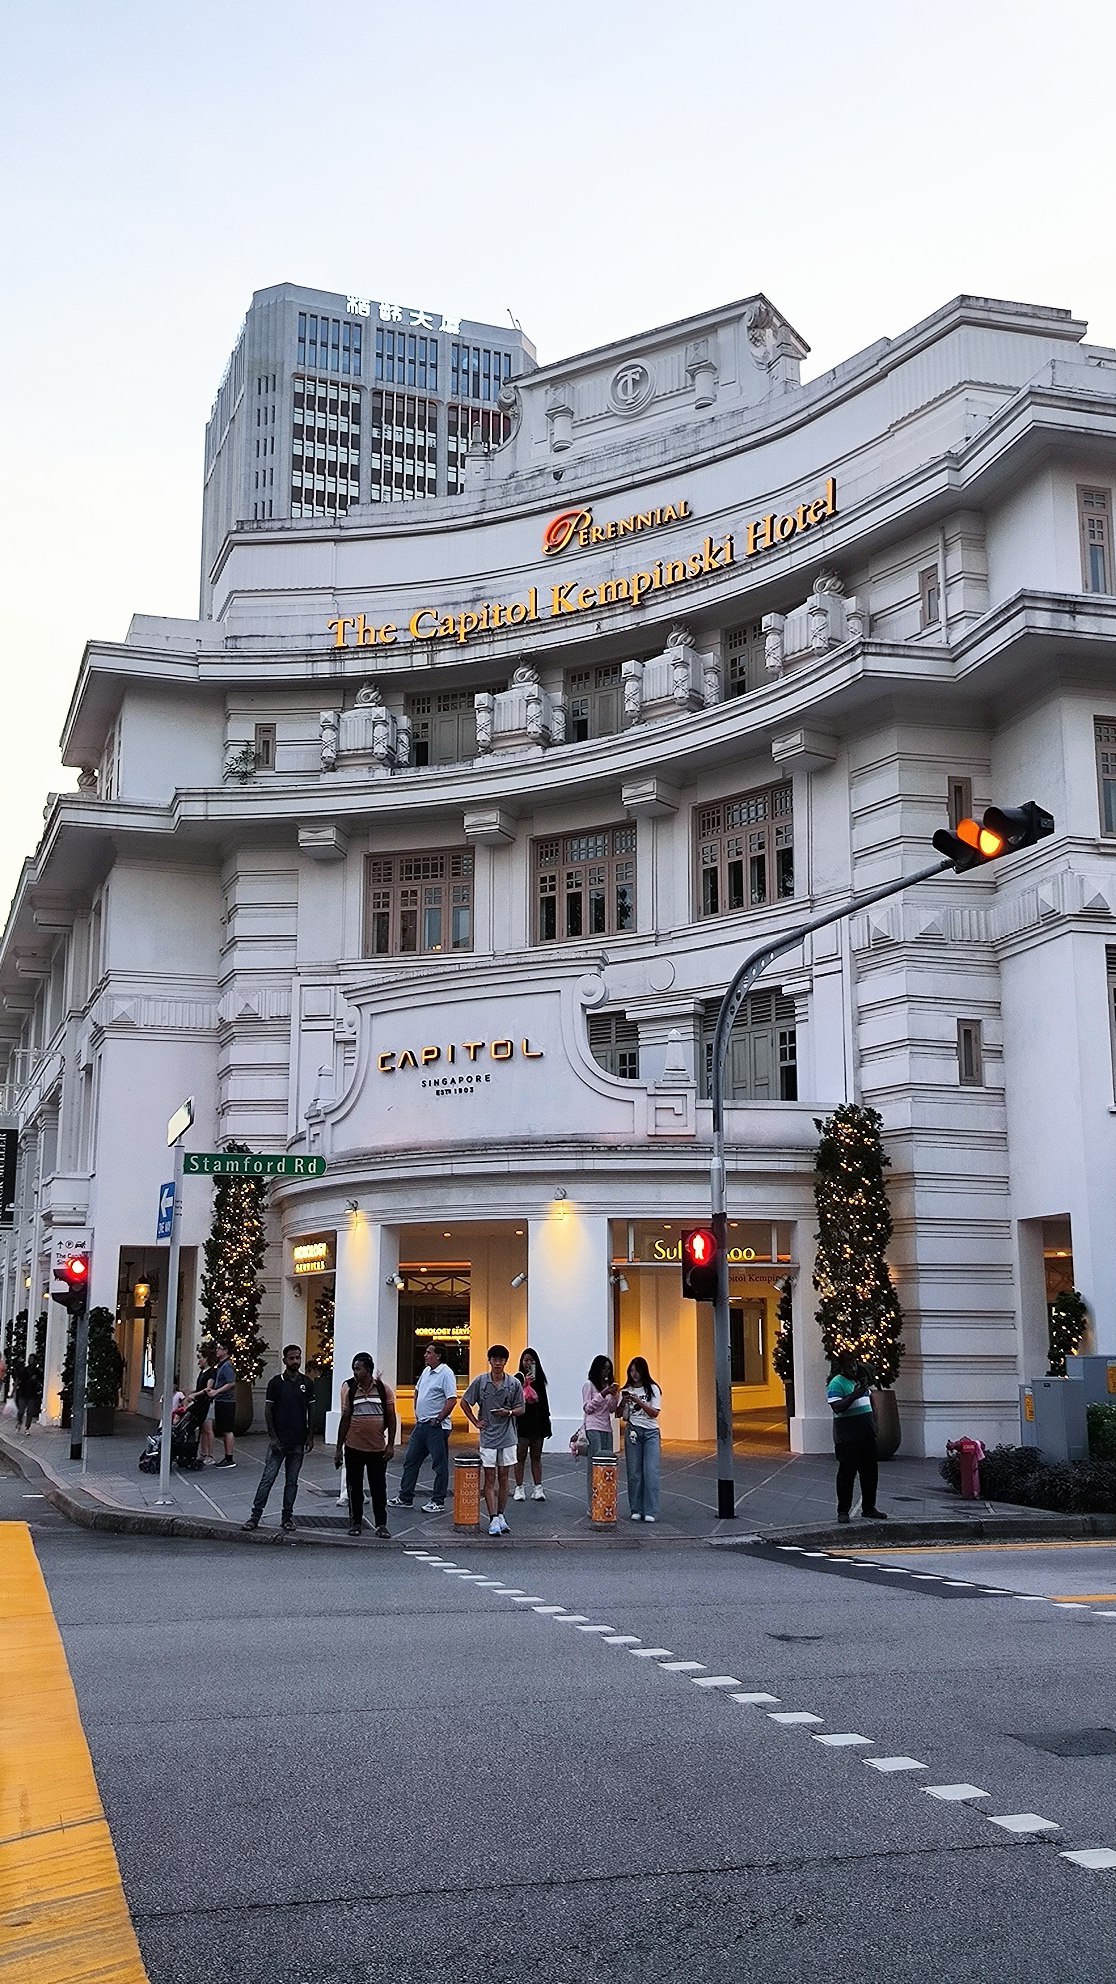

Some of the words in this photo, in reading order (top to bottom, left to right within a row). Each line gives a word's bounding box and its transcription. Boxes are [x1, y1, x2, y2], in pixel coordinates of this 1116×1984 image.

[328, 613, 398, 649] The
[409, 586, 540, 645] Capitol
[550, 533, 736, 618] Kempinski
[744, 476, 838, 559] Hotel
[378, 1037, 543, 1073] CAPITOL
[421, 1074, 491, 1088] SINGAPORE
[189, 1155, 285, 1173] Stamford
[294, 1158, 317, 1174] Rd
